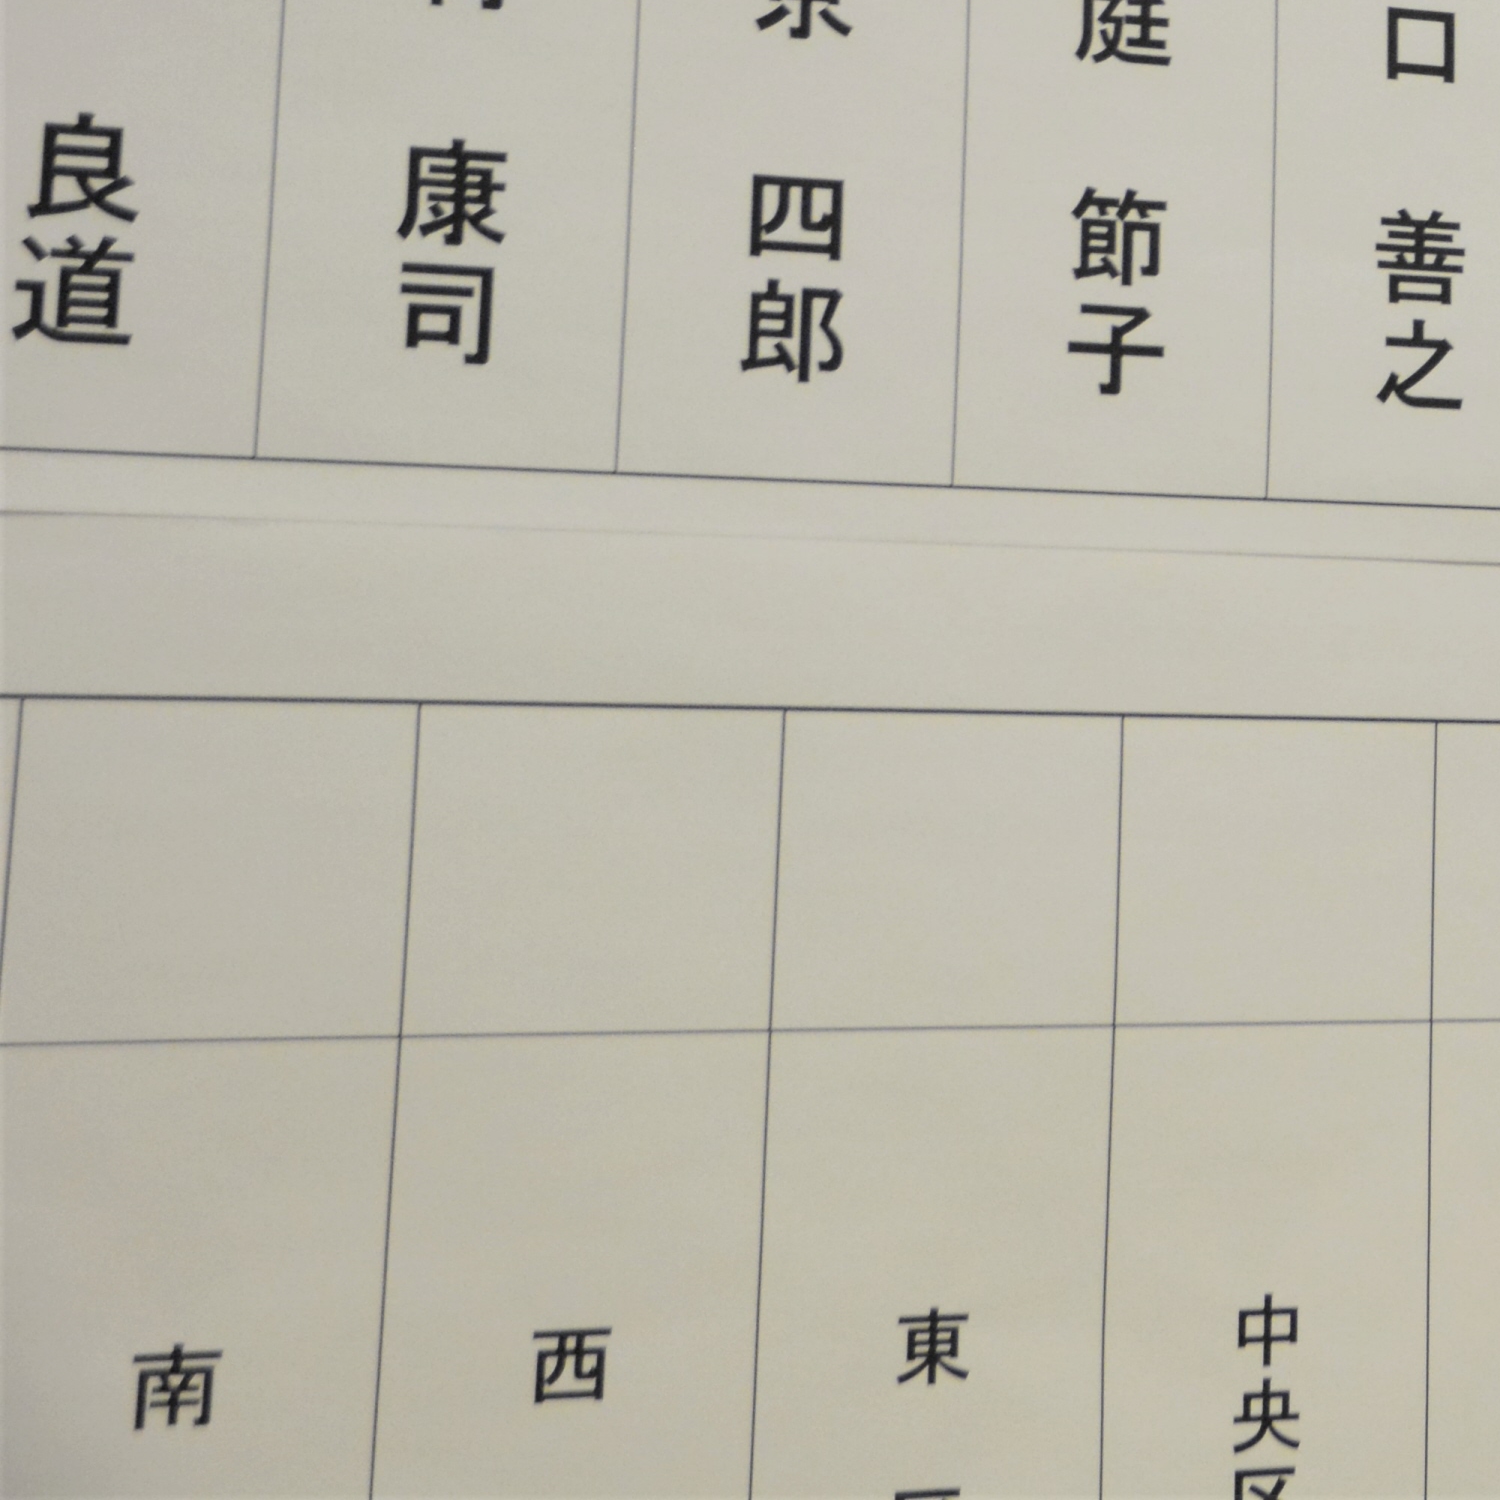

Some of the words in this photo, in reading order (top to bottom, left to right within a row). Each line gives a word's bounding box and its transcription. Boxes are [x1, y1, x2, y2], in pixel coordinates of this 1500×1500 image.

[12, 113, 137, 345] 良道
[397, 139, 506, 364] 康司
[741, 175, 843, 382] 四郎
[1068, 187, 1166, 395] 節子
[1376, 209, 1465, 409] 善之
